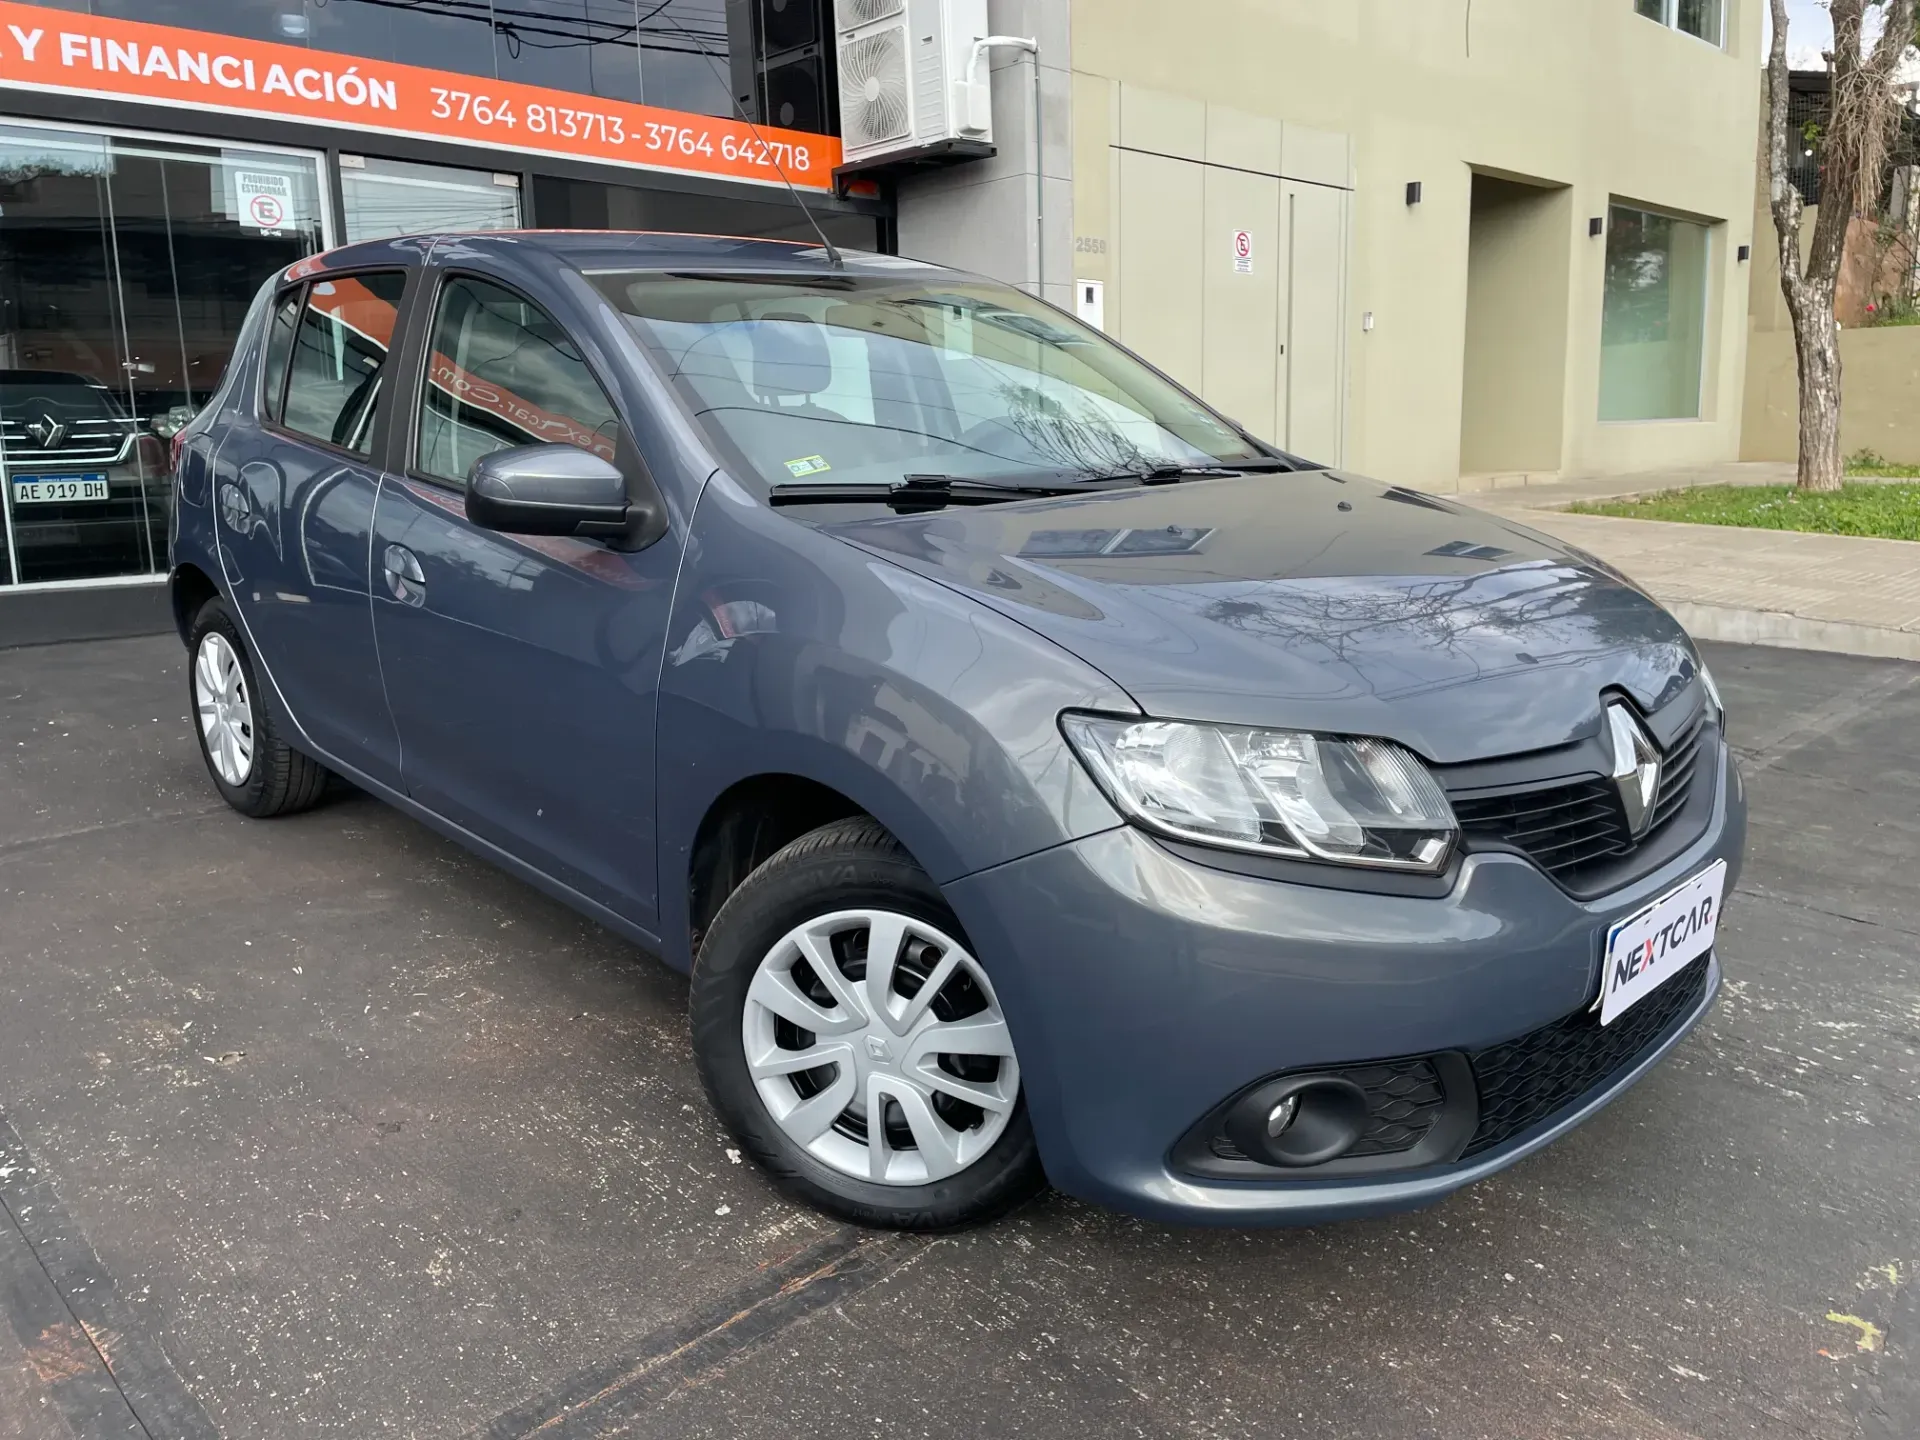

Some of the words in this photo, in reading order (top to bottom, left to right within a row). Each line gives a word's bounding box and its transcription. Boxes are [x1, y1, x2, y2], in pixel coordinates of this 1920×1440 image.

[8, 24, 44, 62] Y
[430, 87, 517, 129] 3764
[721, 135, 810, 171] 642718
[242, 174, 284, 186] PROHIBIDO
[241, 184, 287, 197] ESTACIONAR
[20, 485, 39, 500] AE
[47, 483, 77, 499] 919
[84, 482, 104, 498] DH
